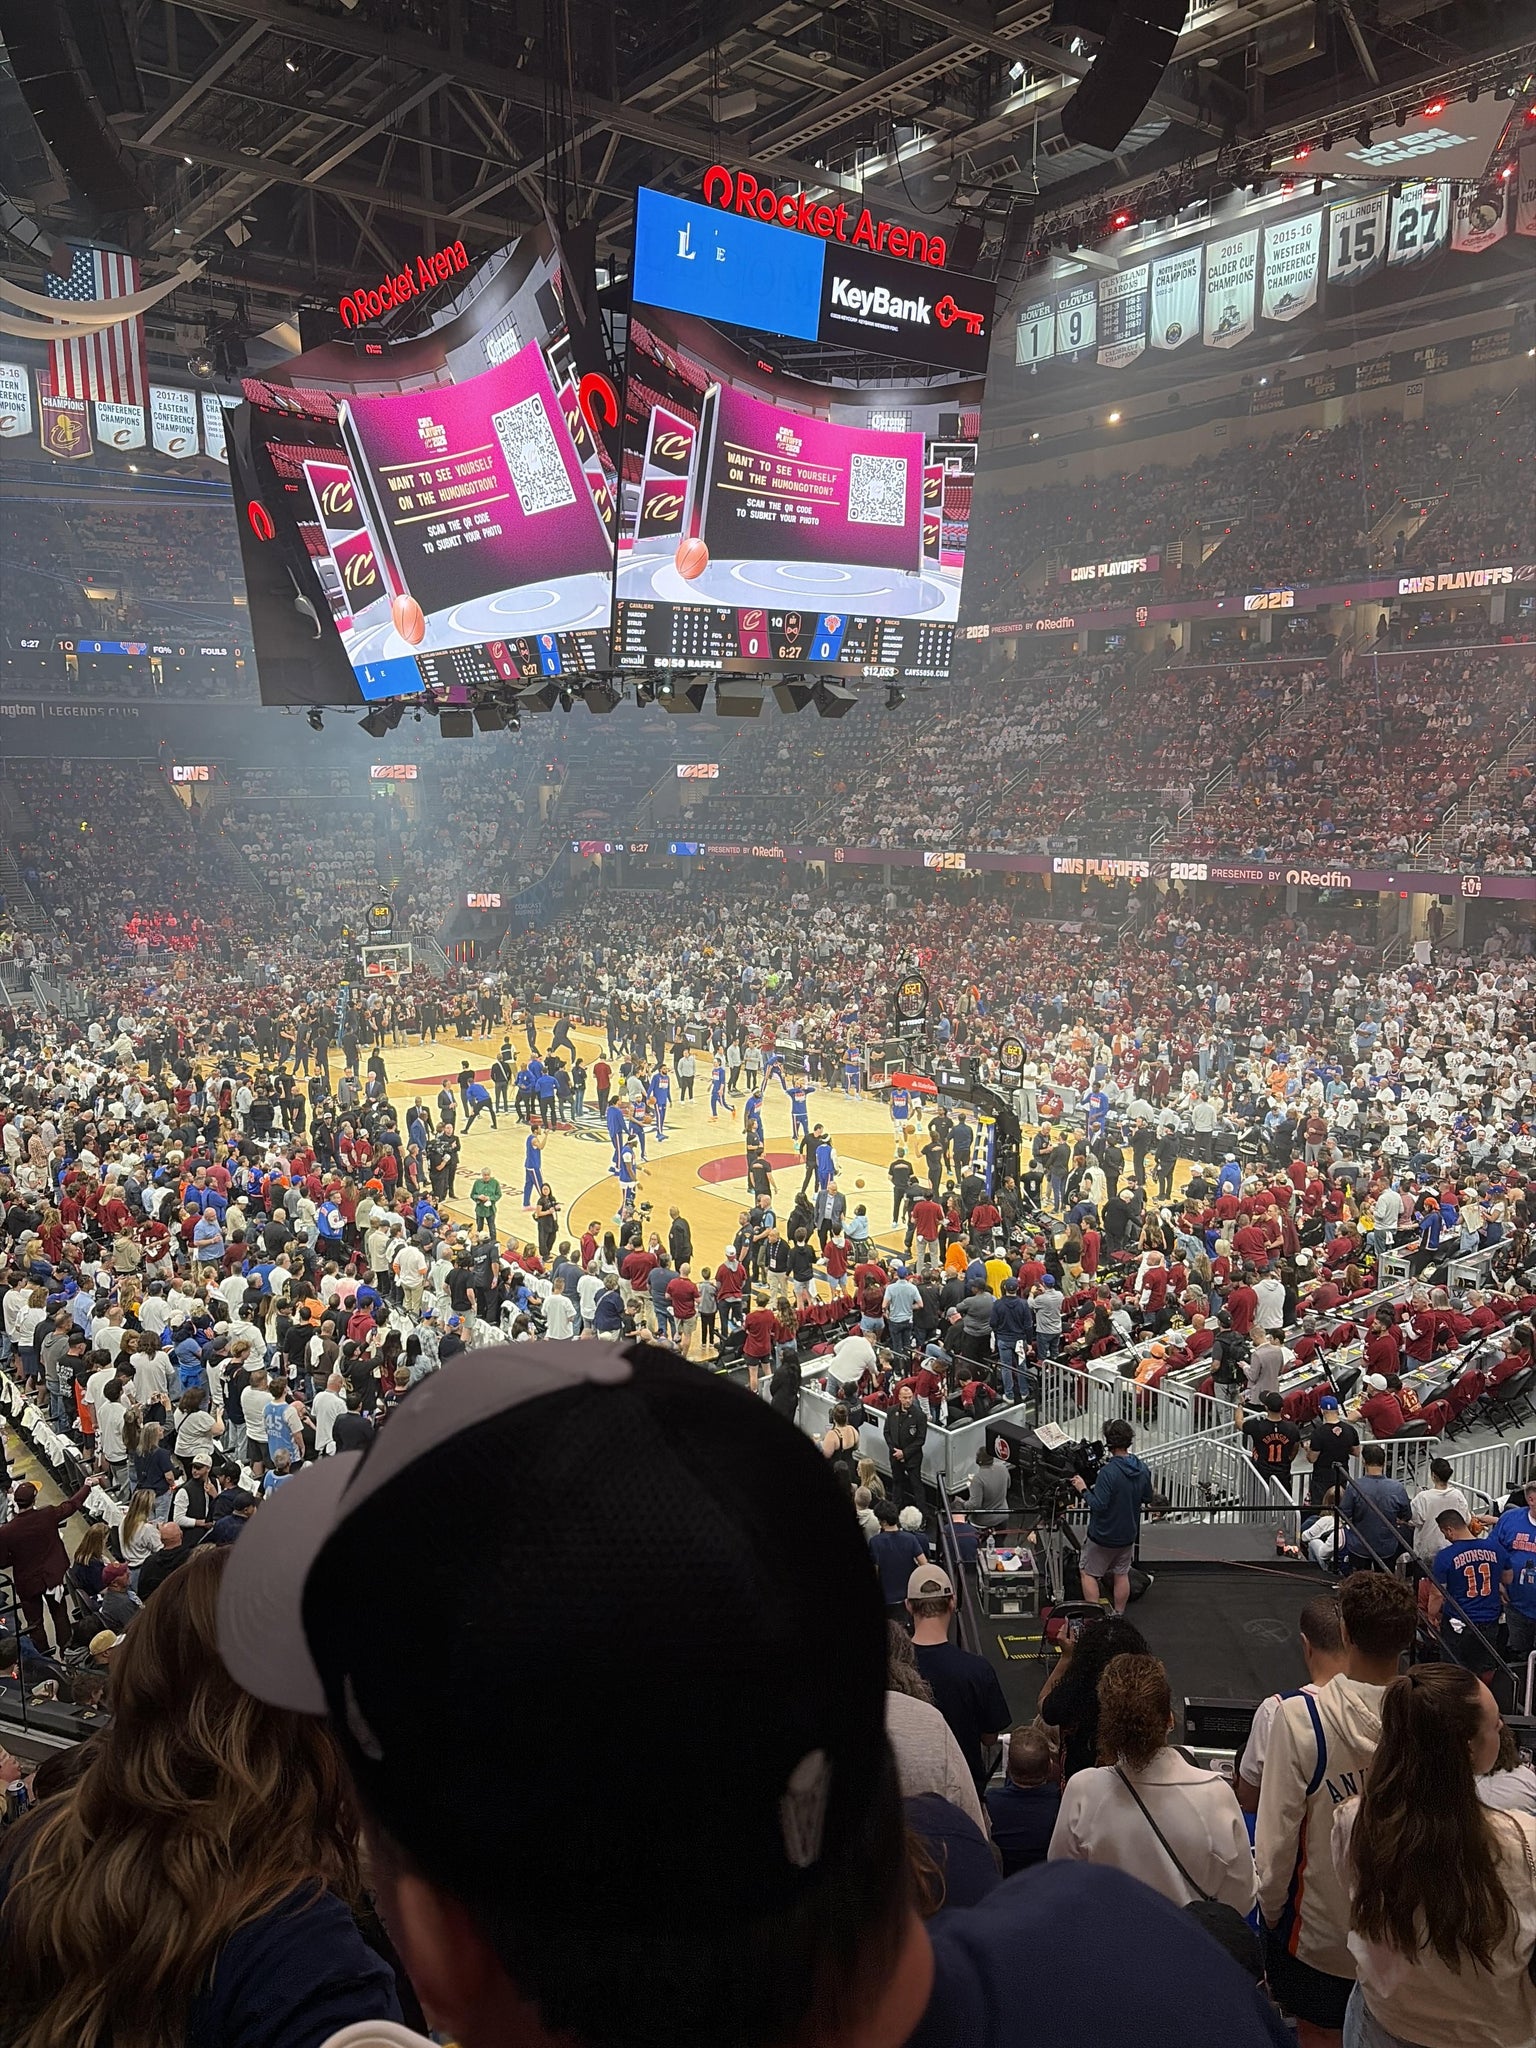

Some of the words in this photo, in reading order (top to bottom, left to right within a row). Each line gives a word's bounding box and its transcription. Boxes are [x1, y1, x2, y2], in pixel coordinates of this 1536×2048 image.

[1345, 141, 1397, 160] LET
[1398, 128, 1450, 146] EM
[1363, 134, 1478, 167] KNOW.
[736, 171, 849, 242] Rocket
[852, 208, 947, 266] Arena
[1334, 201, 1382, 224] CALLANDER
[1397, 200, 1441, 250] 27
[1272, 223, 1313, 246] 2015-16
[1338, 218, 1377, 267] 15
[716, 248, 726, 263] E
[1221, 242, 1243, 258] 2016
[1273, 240, 1311, 261] WESTERN
[1174, 257, 1196, 271] DIVISION
[1208, 259, 1237, 279] CALDER
[1239, 254, 1255, 270] CUP
[1266, 252, 1317, 277] CONFERENCE
[353, 263, 420, 323] Rocket
[416, 240, 469, 292] Arena
[1100, 268, 1146, 290] CLEVELAND
[1156, 265, 1197, 288] CHAMPIONS
[1208, 269, 1254, 294] CHAMPIONS
[1267, 268, 1313, 290] CHAMPIONS
[1108, 279, 1138, 297] BARONS
[831, 276, 932, 324] KeyBank
[1059, 291, 1094, 309] GLOVER
[1021, 305, 1051, 322] BOWER
[1070, 311, 1082, 346] 9
[1030, 324, 1038, 358] 1
[1414, 348, 1436, 362] PLAY
[1426, 357, 1448, 370] OFFS
[156, 390, 189, 403] 2017-18
[1407, 384, 1423, 395] 209
[42, 396, 84, 411] CHAMPIONS
[97, 403, 141, 417] CONFERENCE
[158, 402, 188, 414] EASTERN
[100, 413, 140, 427] CHAMPIONS
[153, 412, 195, 425] CONFERENCE
[156, 422, 194, 435] CHAMPIONS
[387, 474, 415, 492] WANT
[418, 472, 432, 486] TO
[435, 467, 453, 482] SEE
[454, 456, 494, 478] YOURSELF
[727, 451, 754, 468] WANT
[759, 460, 771, 472] TO
[776, 464, 792, 476] SEE
[797, 468, 837, 483] YOURSELF
[729, 468, 744, 481] ON
[749, 473, 767, 486] THE
[772, 478, 834, 497] HUMONGOTRON?
[398, 495, 414, 511] ON
[416, 491, 437, 507] THE
[438, 475, 498, 502] HUMONGOTRON?
[746, 498, 766, 509] SCAN
[769, 501, 782, 511] THE
[784, 504, 794, 513] QR
[796, 505, 813, 514] CODE
[427, 522, 447, 537] SCAN
[447, 519, 462, 532] THE
[463, 516, 473, 529] QR
[474, 512, 491, 525] CODE
[736, 508, 747, 518] TO
[750, 510, 777, 521] SUBMIT
[780, 513, 796, 523] YOUR
[799, 516, 820, 525] PHOTO
[422, 543, 435, 554] TO
[436, 535, 462, 551] SUBMIT
[463, 530, 481, 543] YOUR
[482, 524, 503, 539] PHOTO
[1070, 565, 1096, 582] CAVS
[1097, 558, 1147, 578] PLAYOFFS
[1398, 576, 1435, 595] CAVS
[1437, 566, 1513, 591] PLAYOFFS
[629, 602, 654, 610] CAVALIERS
[771, 617, 783, 628] 1Q
[966, 624, 990, 639] 2026
[991, 624, 1023, 634] PRESENTED
[1025, 622, 1034, 630] BY
[1044, 616, 1074, 631] Redfin
[20, 640, 40, 649] 6:27
[57, 641, 74, 652] 1Q
[94, 643, 101, 652] 0
[153, 646, 172, 655] FG%
[179, 647, 186, 656] 0
[200, 647, 228, 656] FOULS
[234, 648, 241, 657] 0
[749, 638, 758, 655] 0
[779, 646, 803, 659] 6:27
[821, 642, 830, 658] 0
[503, 662, 511, 676] 0
[521, 663, 538, 677] 6:27
[547, 657, 555, 671] 0
[620, 654, 645, 665] oswald
[687, 659, 723, 669] RAFFLE
[863, 665, 896, 678] $12,053
[904, 668, 950, 678] CAVS5050.COM
[49, 705, 104, 717] LEGENDS
[172, 765, 209, 781] CAVS
[604, 843, 611, 853] 0
[630, 844, 649, 853] 6:27
[671, 844, 677, 854] 0
[707, 846, 741, 854] PRESENTED
[759, 846, 784, 858] Redfin
[1053, 857, 1084, 874] CAVS
[1085, 859, 1150, 877] PLAYOFFS
[1170, 862, 1208, 881] 2026
[1211, 868, 1264, 881] PRESENTED
[1268, 870, 1281, 881] BY
[1300, 870, 1352, 888] Redfin
[467, 893, 501, 908] CAVS
[904, 983, 921, 995] 6:27
[1007, 1045, 1022, 1056] 6:27
[1403, 1389, 1418, 1408] 45
[265, 1414, 283, 1431] 45
[1268, 1444, 1282, 1462] 11
[1453, 1549, 1498, 1570] BRUNSON
[1464, 1562, 1492, 1598] 11
